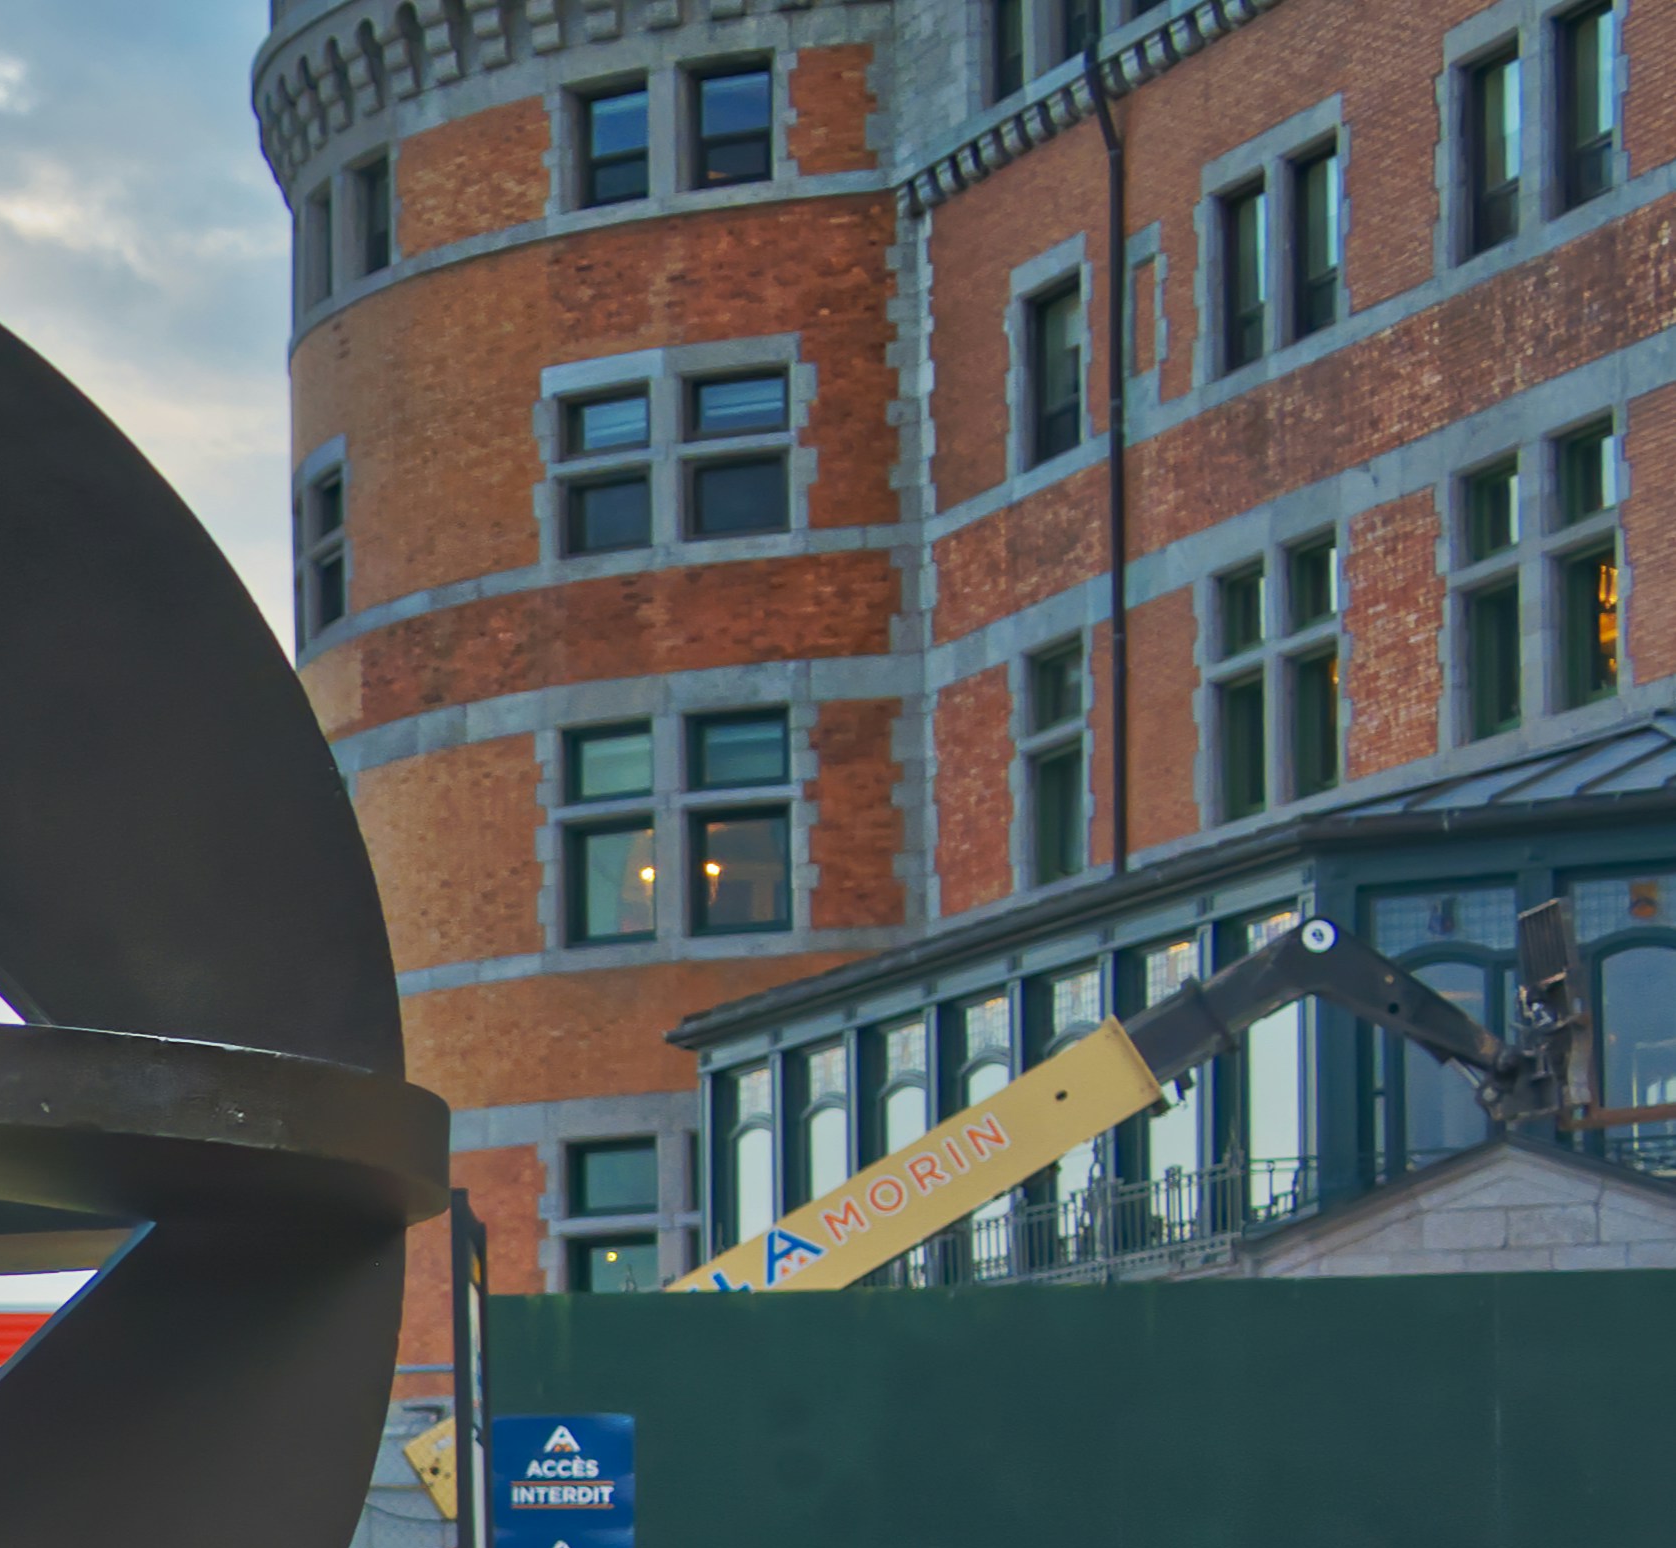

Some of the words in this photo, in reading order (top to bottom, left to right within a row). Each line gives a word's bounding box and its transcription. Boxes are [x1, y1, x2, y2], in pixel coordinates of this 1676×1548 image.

[822, 1115, 1008, 1243] MORIN
[526, 1455, 599, 1479] ACCÈS
[512, 1486, 614, 1504] INTERDIT
